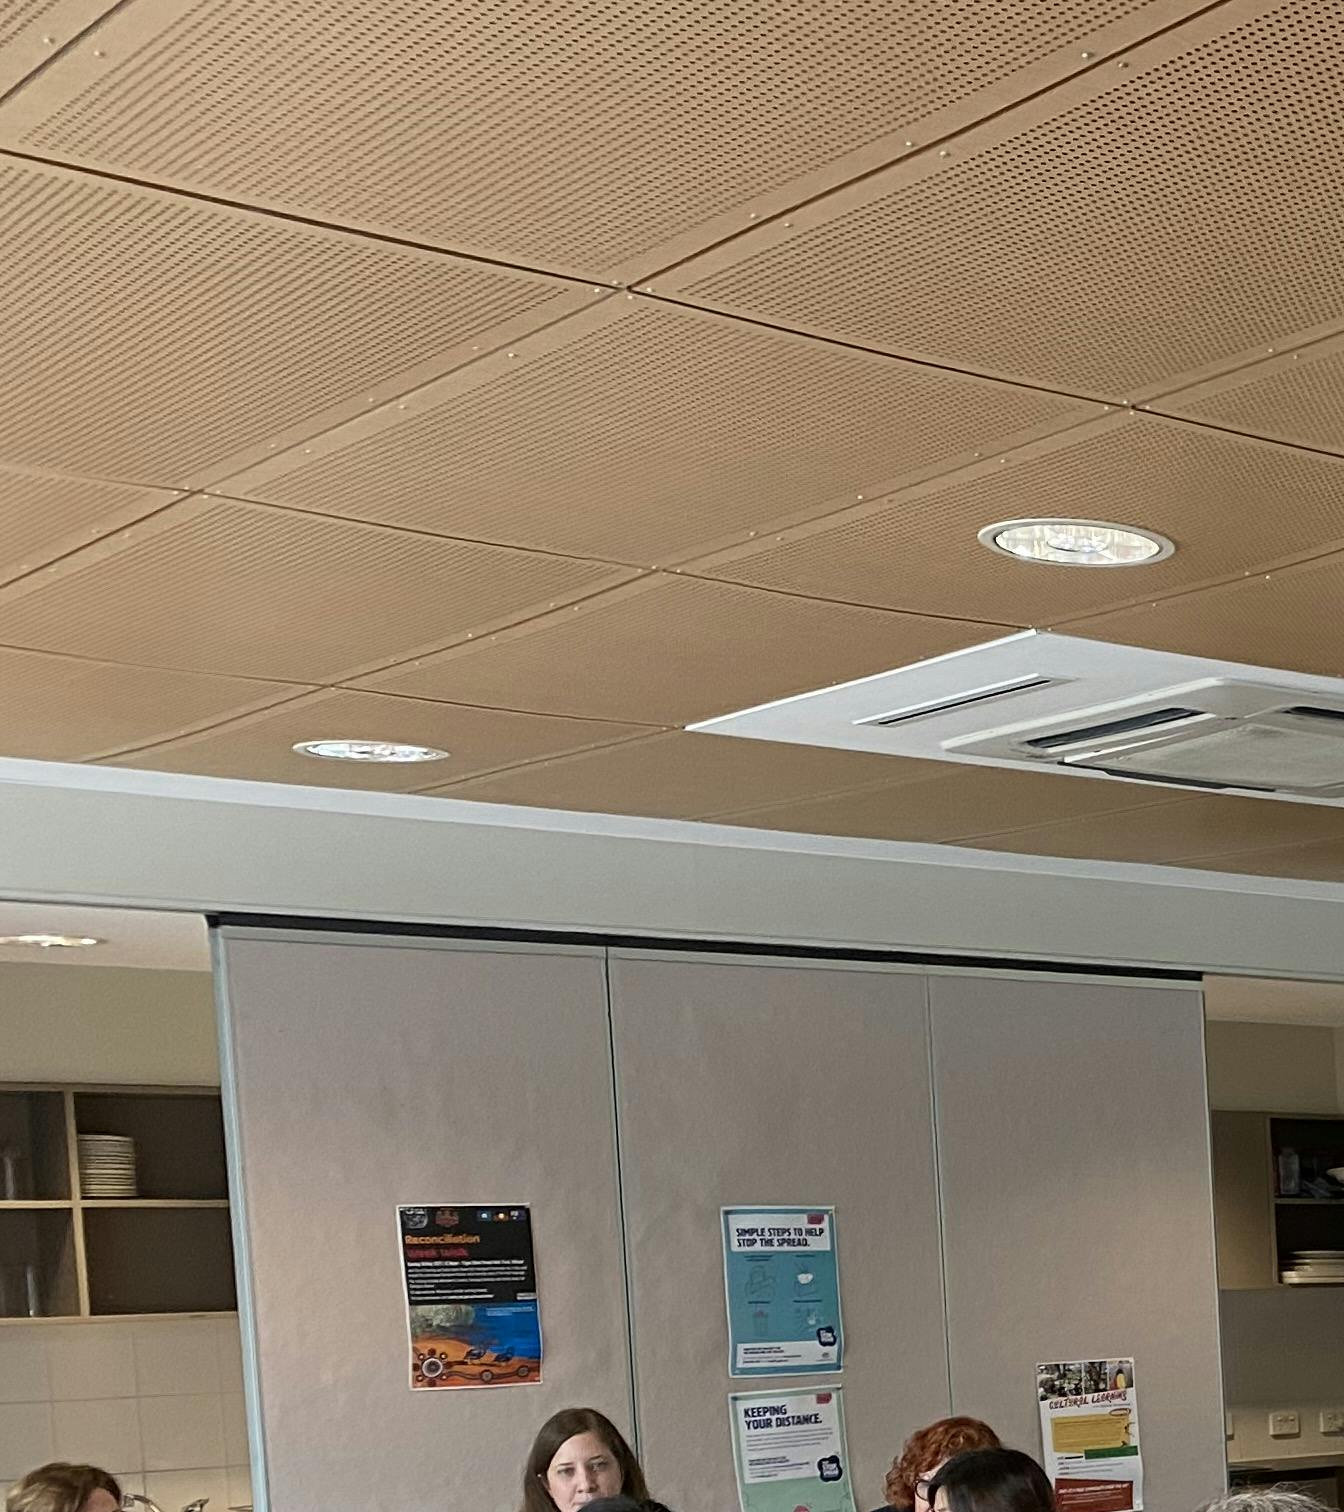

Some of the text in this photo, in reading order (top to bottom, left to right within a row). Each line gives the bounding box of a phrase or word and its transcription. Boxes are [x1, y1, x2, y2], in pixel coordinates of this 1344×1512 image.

[736, 1227, 825, 1237] SIMPLE STEPS TO HELP
[405, 1234, 480, 1245] Reconciliation
[737, 1238, 811, 1248] STOP THE SPREAD.
[743, 1404, 788, 1418] KEEPING
[744, 1413, 823, 1430] YOUR DISTANCE.
